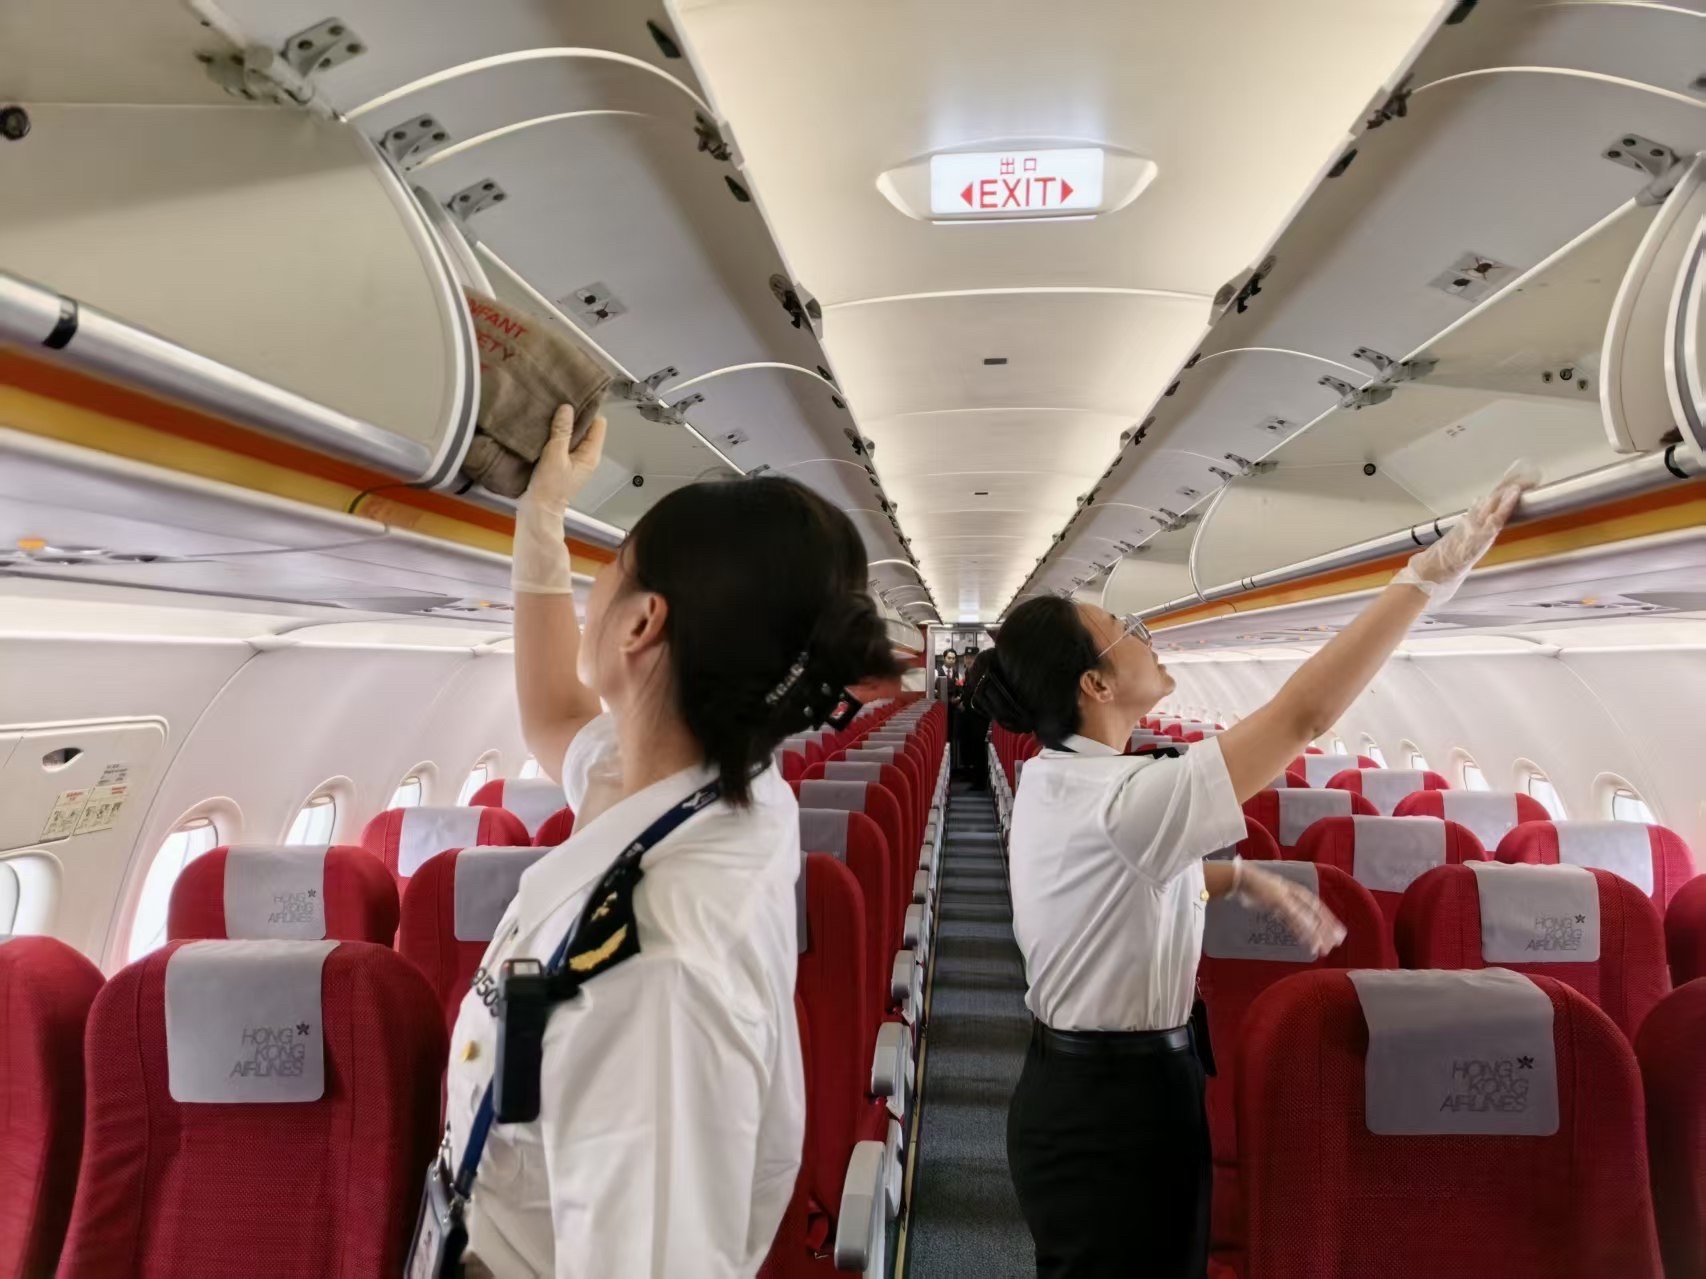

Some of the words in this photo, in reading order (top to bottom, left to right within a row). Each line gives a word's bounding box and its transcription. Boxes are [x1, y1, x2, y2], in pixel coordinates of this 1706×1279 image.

[1000, 157, 1037, 175] 出口
[980, 177, 1056, 209] EXIT
[467, 298, 526, 339] NFANT
[477, 330, 515, 361] ETY
[241, 1027, 293, 1045] HONG
[255, 1044, 305, 1061] KONG
[229, 1059, 304, 1077] AIRLINES
[1453, 1060, 1513, 1078] HONG
[1470, 1078, 1529, 1095] KONG
[1440, 1094, 1527, 1112] AIRLINES
